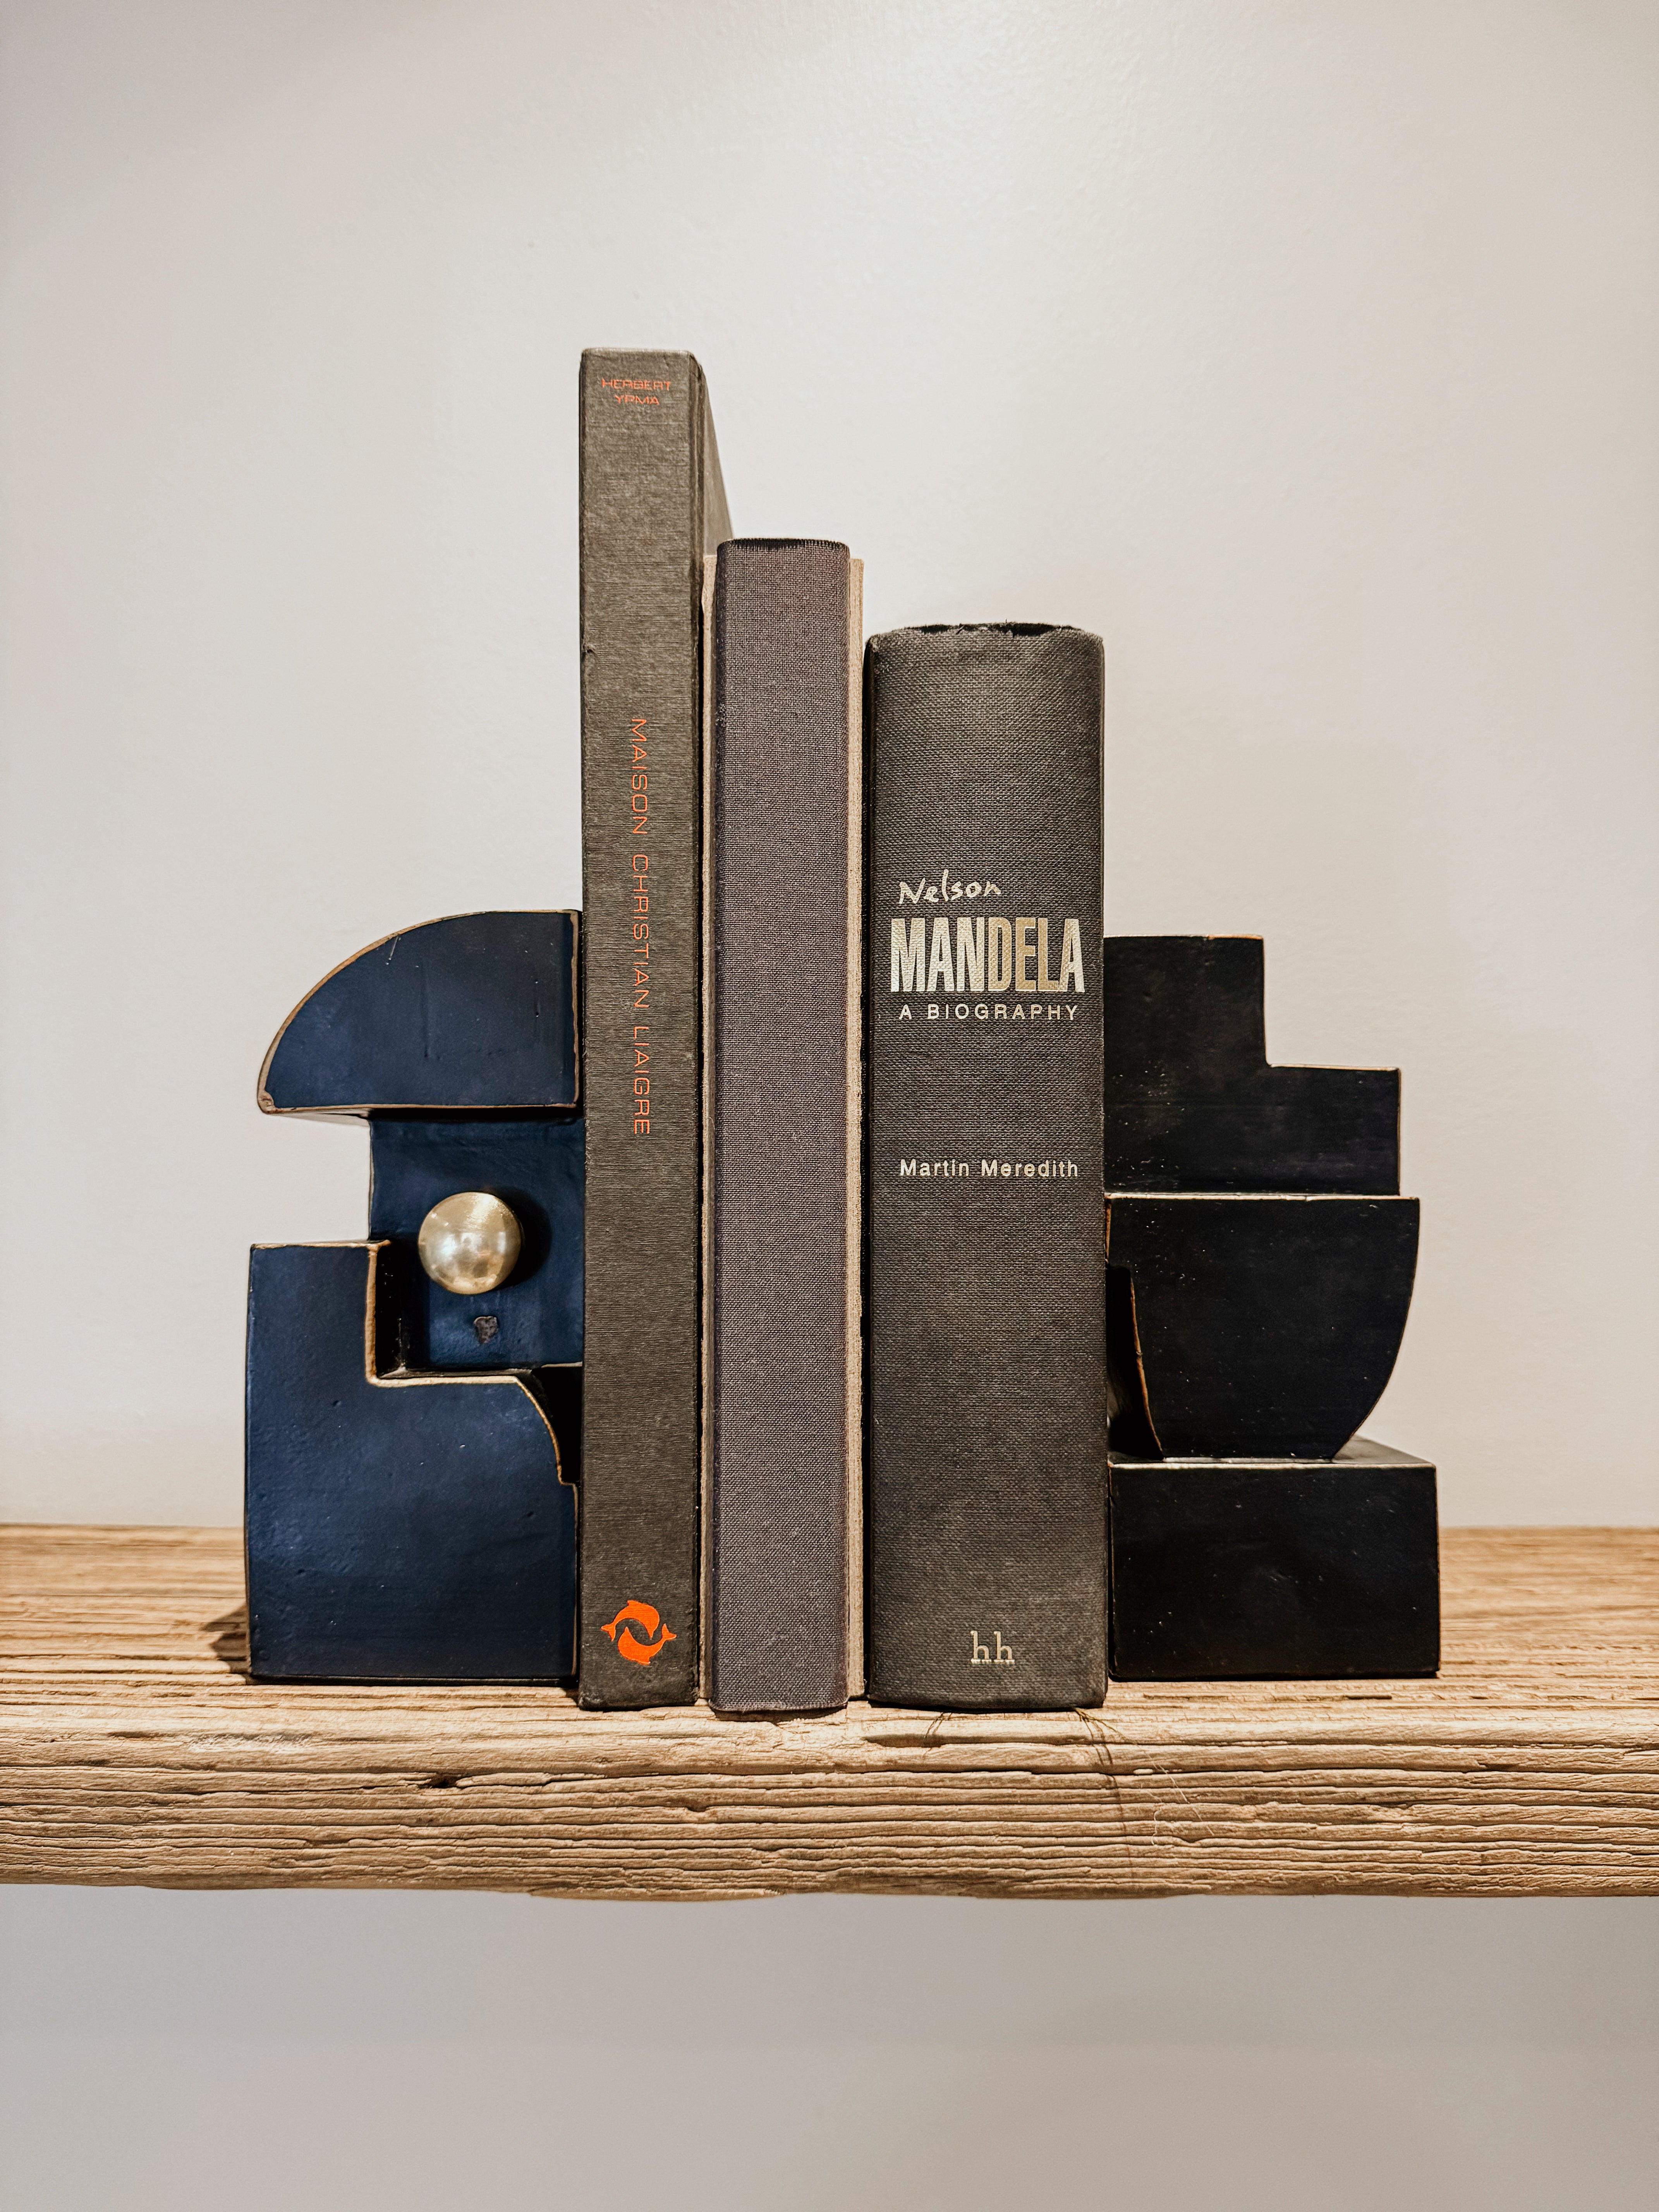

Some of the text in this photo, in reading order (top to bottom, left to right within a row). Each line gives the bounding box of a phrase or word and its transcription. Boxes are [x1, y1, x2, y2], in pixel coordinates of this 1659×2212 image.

[601, 378, 671, 391] HERBERT
[898, 869, 1001, 904] Nelson
[631, 718, 650, 1135] MAISON CHRISTIAN LIAIGRE
[890, 917, 1085, 993] MANDELA
[899, 1003, 1078, 1020] A BIOGRAPHY
[900, 1159, 1078, 1177] Martin Meredith
[970, 1630, 1015, 1664] hh
